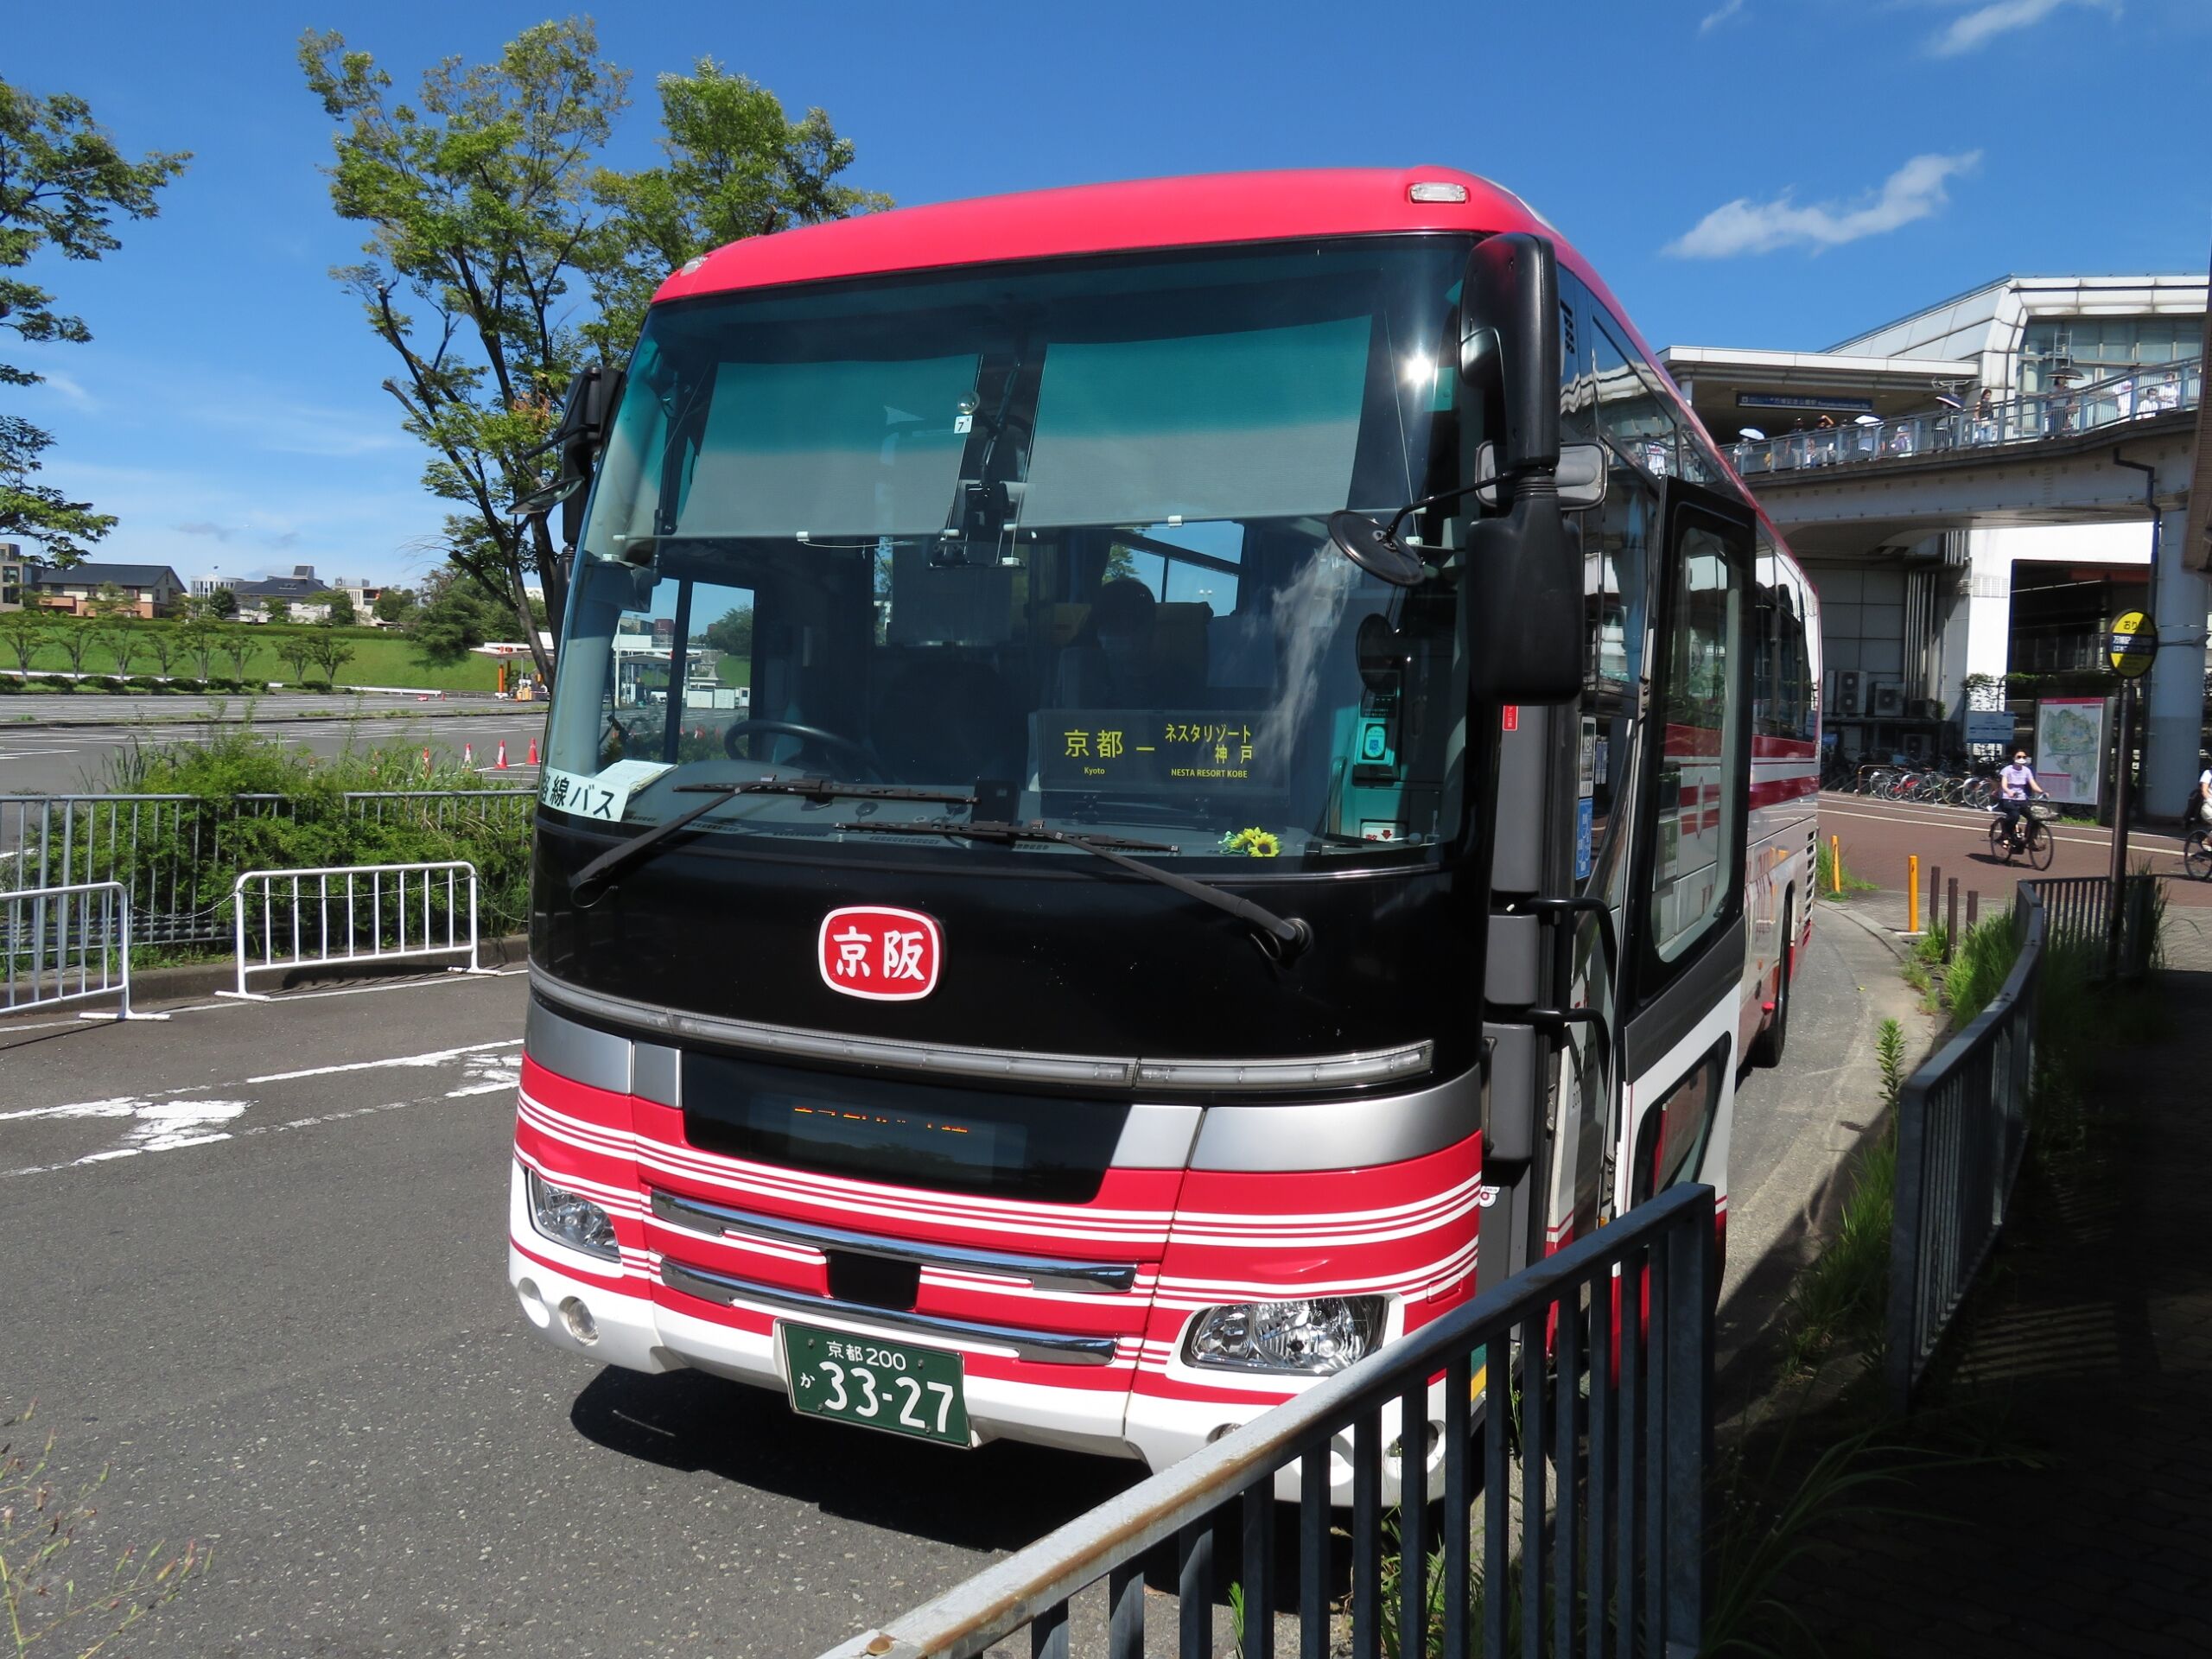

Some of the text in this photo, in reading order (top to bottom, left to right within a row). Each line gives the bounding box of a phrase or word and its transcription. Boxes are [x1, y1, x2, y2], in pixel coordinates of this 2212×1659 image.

[1165, 723, 1251, 743] ネスタリゾート
[1064, 728, 1123, 759] 京都
[1214, 744, 1253, 765] 神戸
[1084, 766, 1105, 776] Kyoto
[1171, 768, 1248, 778] NESTA RESORT KOBE
[832, 925, 925, 981] 京阪
[800, 1372, 816, 1389] か
[819, 1361, 954, 1433] 33-27
